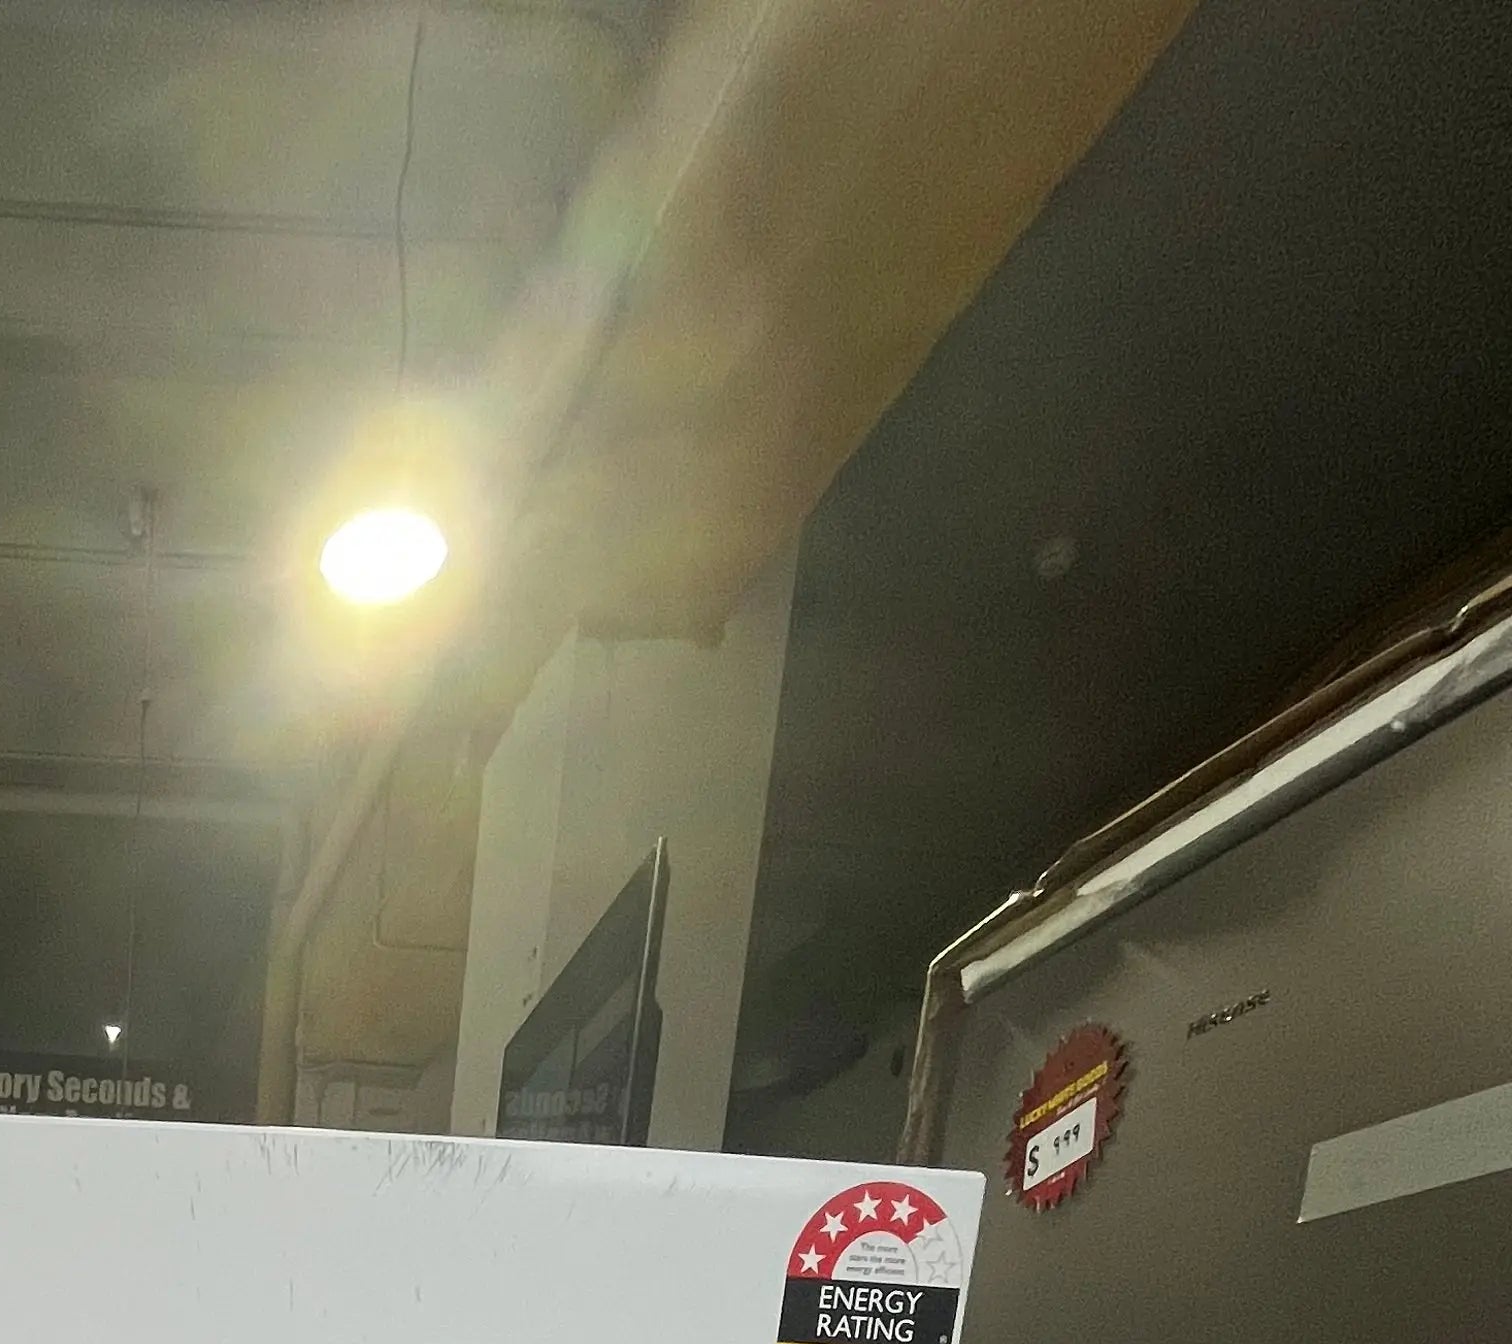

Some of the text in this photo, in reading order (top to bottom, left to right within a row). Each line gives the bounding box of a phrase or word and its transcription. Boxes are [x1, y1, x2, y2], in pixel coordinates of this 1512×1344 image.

[47, 1069, 167, 1109] Seconds
[172, 1083, 192, 1111] &
[818, 1285, 924, 1316] ENERGY
[816, 1313, 916, 1343] RATING
